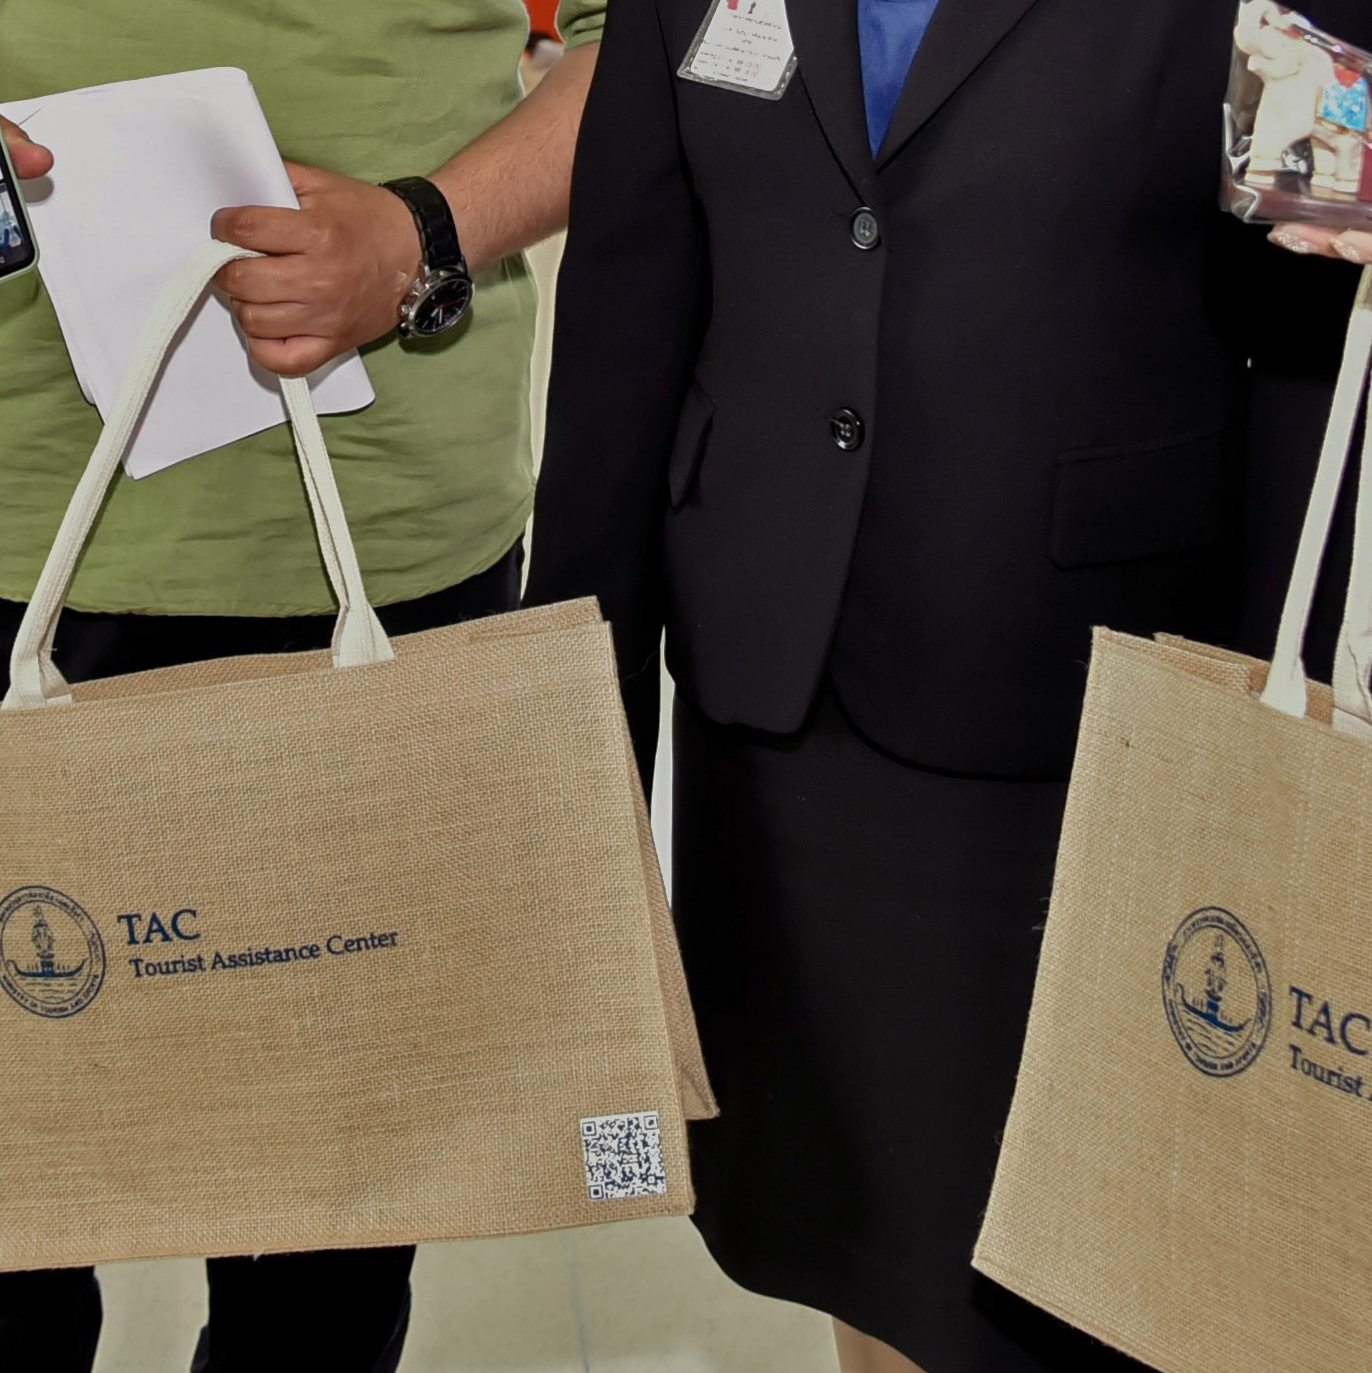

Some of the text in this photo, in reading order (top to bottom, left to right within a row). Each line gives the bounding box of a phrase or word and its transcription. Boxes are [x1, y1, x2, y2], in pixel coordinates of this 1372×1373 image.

[117, 909, 201, 946] TAC
[129, 931, 399, 979] Tourist Assistance Center
[1289, 985, 1372, 1056] TAC
[1289, 1044, 1364, 1099] Tourist
